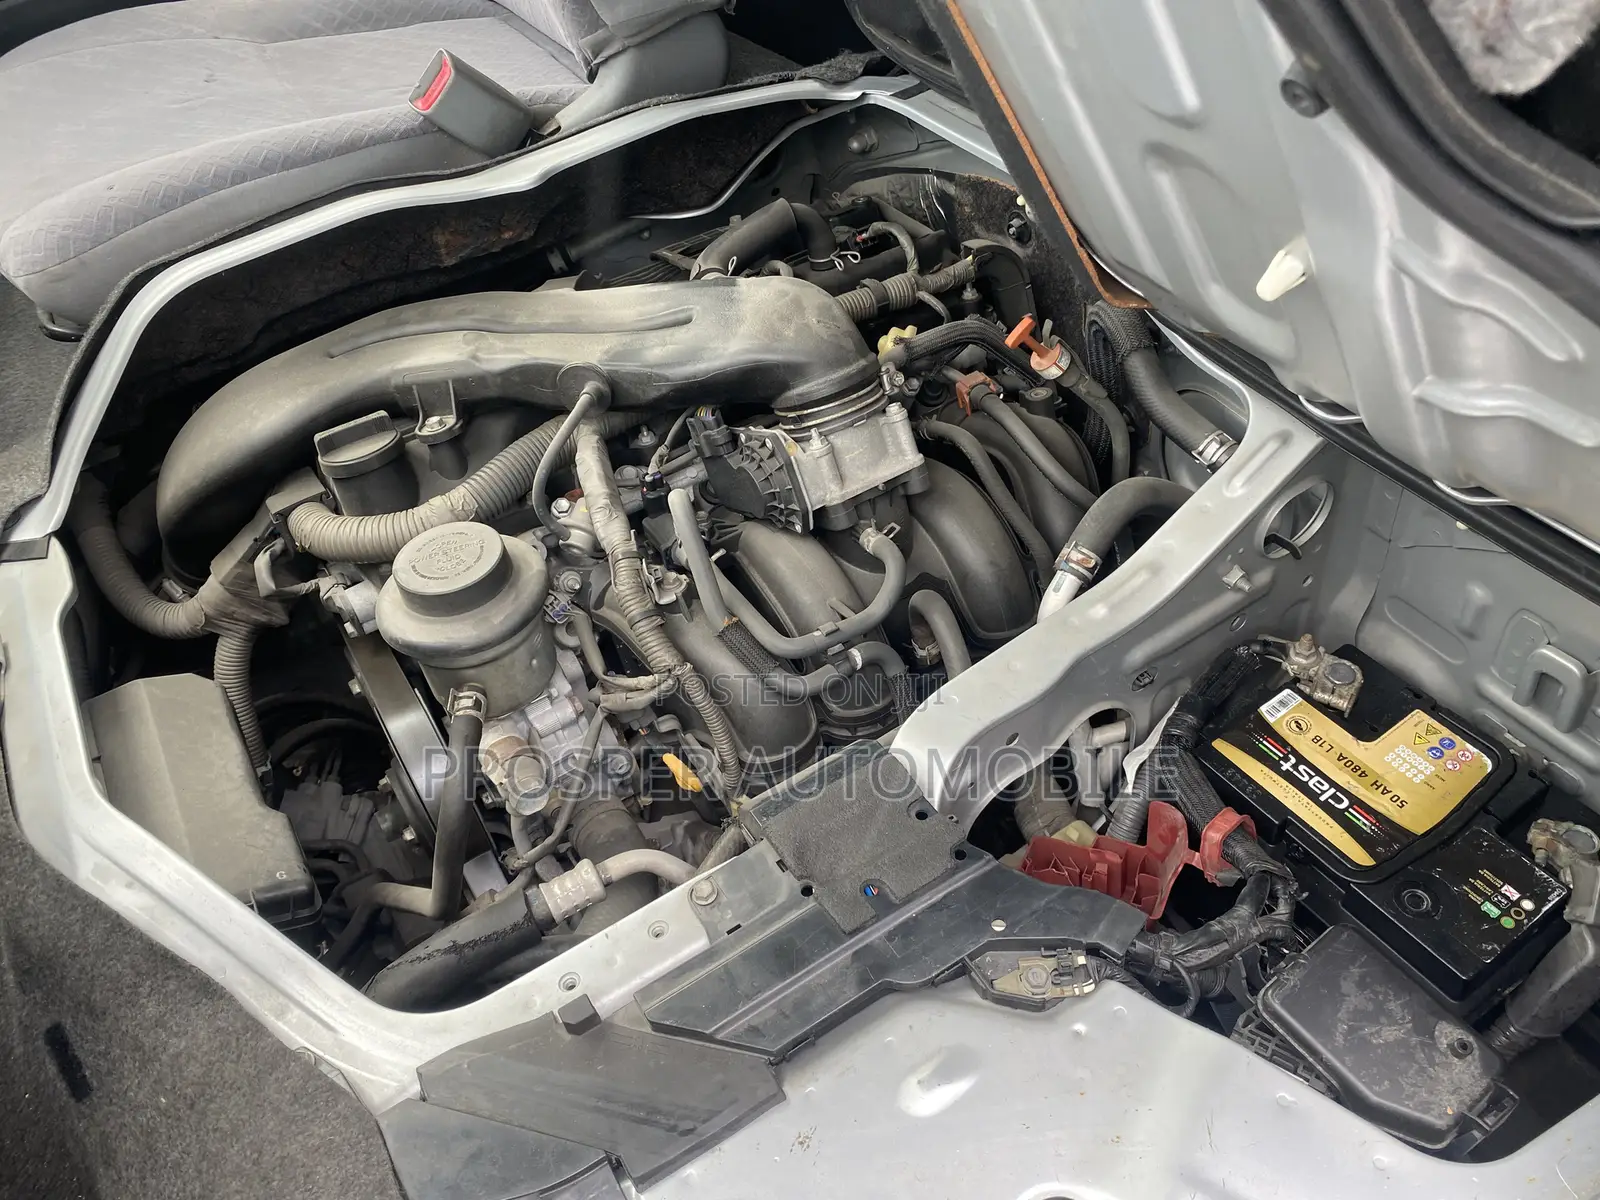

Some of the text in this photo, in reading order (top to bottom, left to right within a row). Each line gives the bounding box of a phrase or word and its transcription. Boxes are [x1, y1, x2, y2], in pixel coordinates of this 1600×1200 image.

[441, 539, 485, 557] STEERING
[1311, 734, 1334, 754] L1B
[1335, 753, 1369, 780] 480A
[1278, 753, 1351, 812] clast
[276, 871, 287, 880] G
